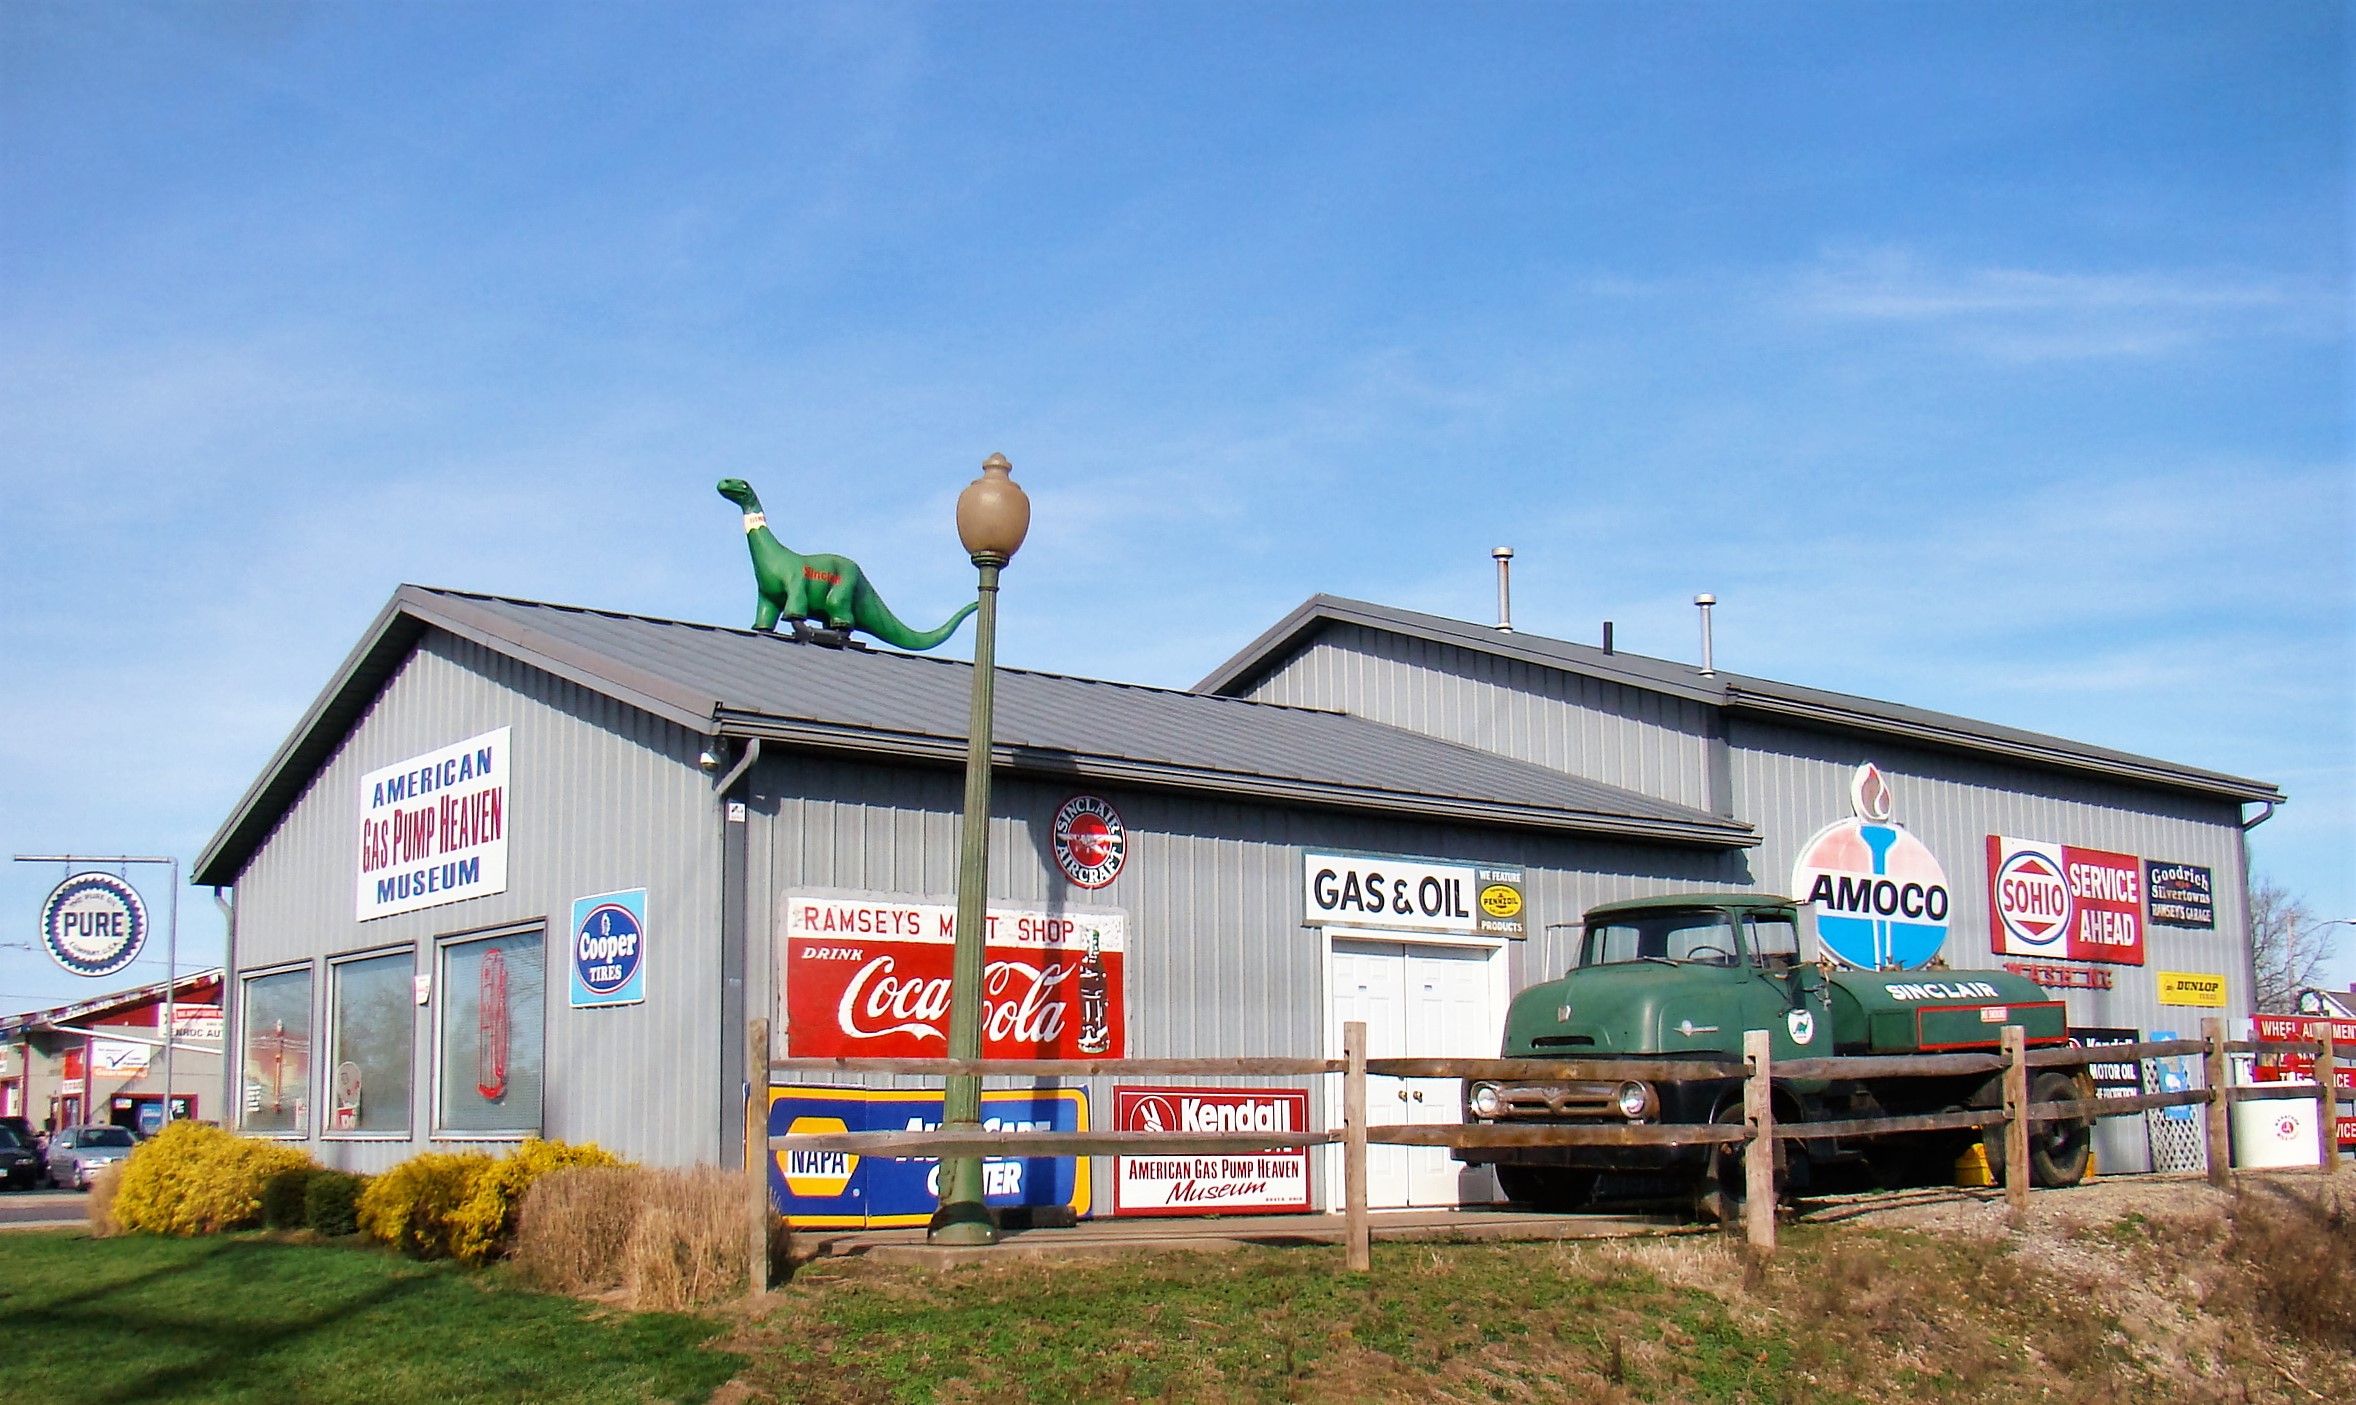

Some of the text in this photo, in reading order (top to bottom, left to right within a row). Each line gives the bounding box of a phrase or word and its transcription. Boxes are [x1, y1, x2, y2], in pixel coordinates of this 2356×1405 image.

[373, 746, 493, 809] AMERICAN
[363, 786, 502, 873] GAS PUMP HEAVEN
[1057, 799, 1121, 834] SINCLAIR
[1057, 847, 1123, 883] AIRCRAFT
[1479, 870, 1521, 882] WE FEATURE
[377, 856, 480, 904] MUSEUM
[2069, 863, 2137, 903] SERVICE
[2151, 866, 2209, 892] Goodrich
[1808, 874, 1948, 921] AMOCO
[2003, 878, 2064, 916] SOHIO
[2151, 885, 2211, 904] Silvertowns
[64, 912, 124, 937] PURE
[940, 913, 999, 939] MT
[1018, 918, 1074, 942] SHOP
[1481, 920, 1523, 932] PRODUCTS
[2080, 909, 2135, 946] AHEAD
[2186, 907, 2211, 922] GARAGE
[580, 931, 638, 964] Cooper
[801, 947, 863, 961] DRINK
[589, 964, 622, 982] TIRES
[1884, 981, 1999, 1000] SINCLAIR
[2176, 981, 2219, 992] DUNLOP
[2089, 1064, 2136, 1079] MOTOR OIL
[1181, 1098, 1291, 1132] Kendall
[791, 1150, 844, 1173] NAPA
[1129, 1158, 1299, 1179] AMERICAN GAS PUMP HEAVEN
[927, 1161, 1022, 1195] CTER
[1166, 1179, 1267, 1204] Museum
